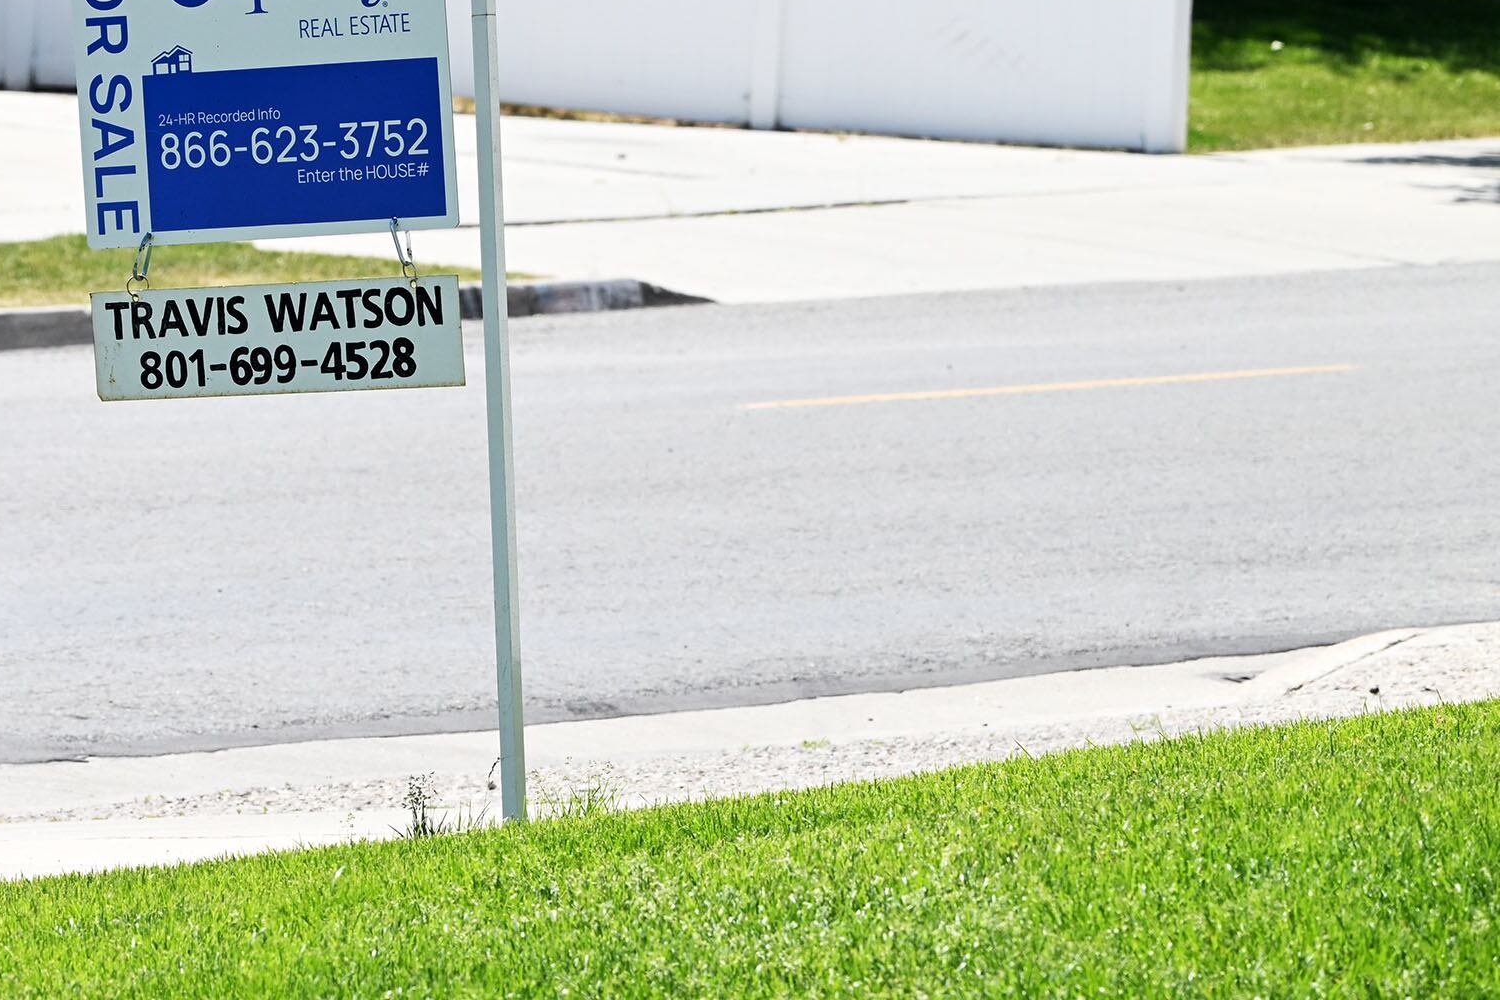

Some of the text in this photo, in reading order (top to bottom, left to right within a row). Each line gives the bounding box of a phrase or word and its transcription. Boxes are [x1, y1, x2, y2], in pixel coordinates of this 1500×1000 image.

[299, 13, 411, 39] REAL ESTATE
[159, 107, 281, 127] 24-HR Recorded Info
[160, 117, 429, 170] 866-623-3752
[89, 74, 140, 236] SALE
[297, 168, 335, 184] Enter
[337, 167, 363, 182] the
[105, 285, 444, 341] TRAVIS WATSON
[139, 337, 417, 390] 801-699-4528
